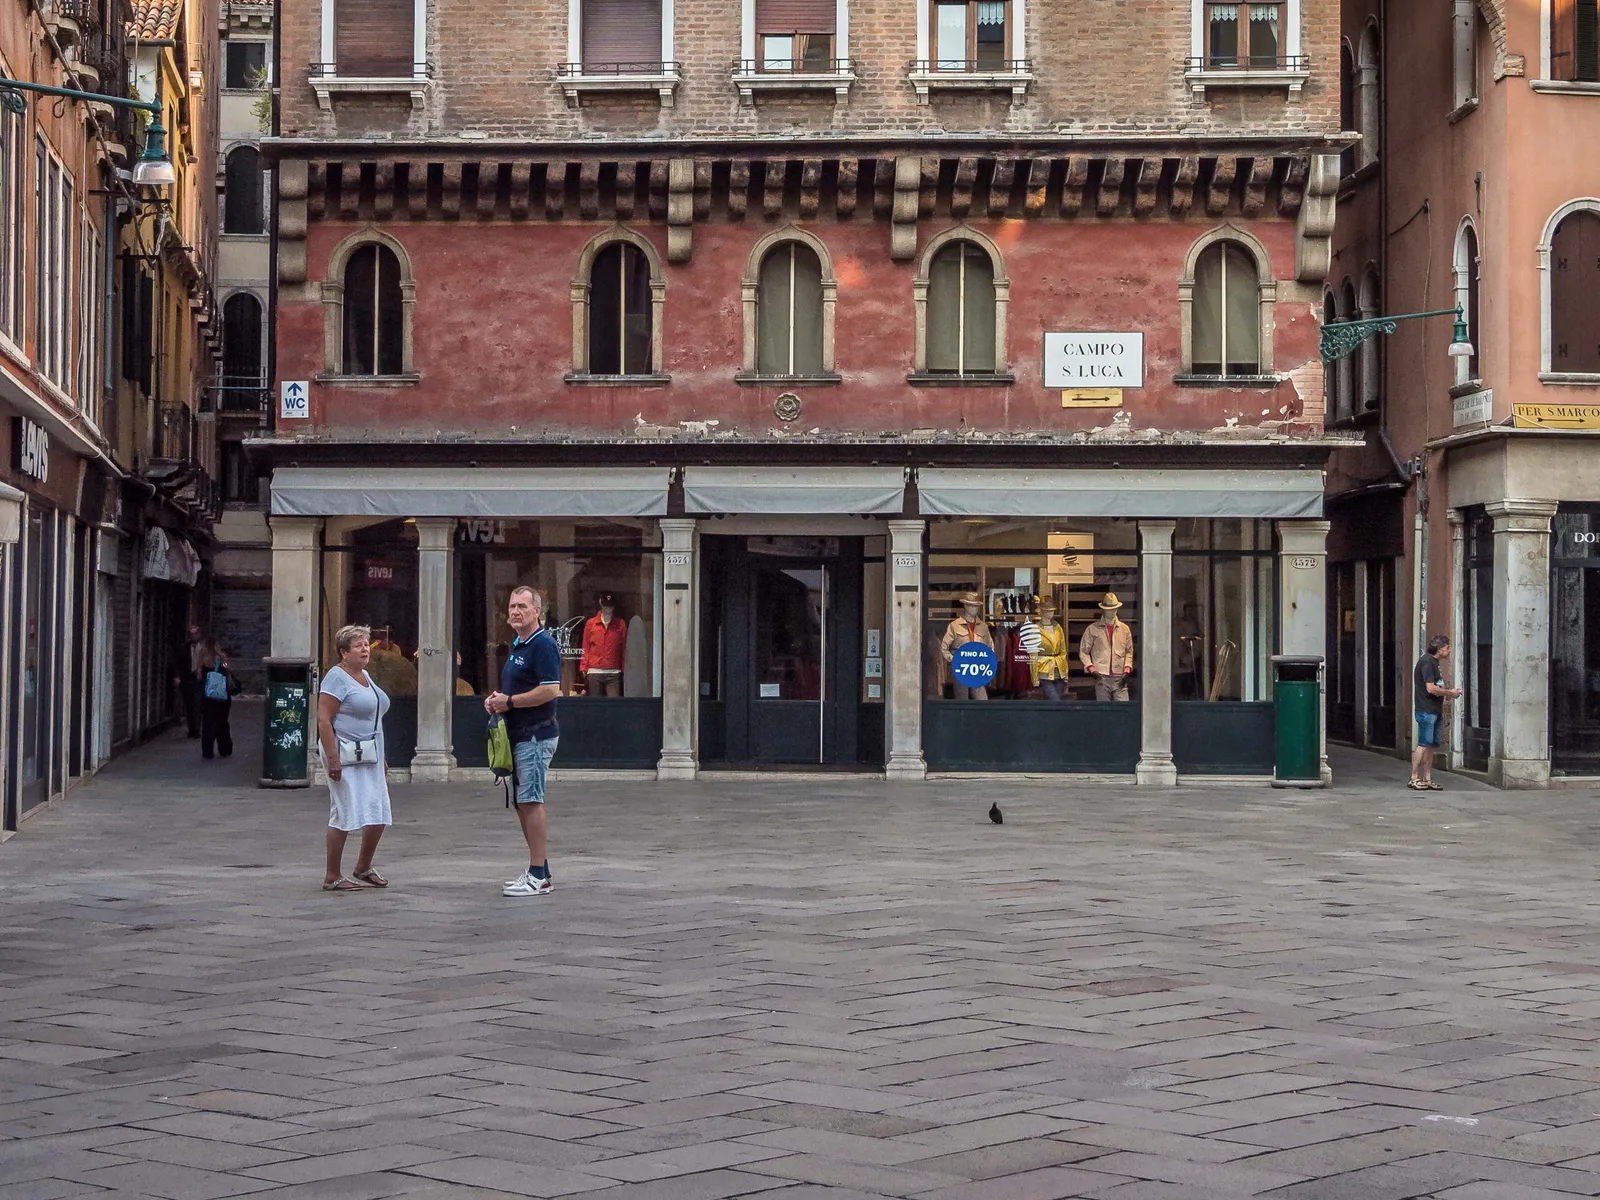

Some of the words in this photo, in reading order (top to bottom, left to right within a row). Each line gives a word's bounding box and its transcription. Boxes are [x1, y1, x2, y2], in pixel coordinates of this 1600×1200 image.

[1063, 343, 1124, 355] CAMPO
[1079, 365, 1123, 378] LUCA
[285, 397, 305, 409] WC
[1518, 406, 1541, 416] PER
[960, 650, 977, 658] FINO
[979, 650, 988, 658] AL
[955, 663, 993, 677] -70%
